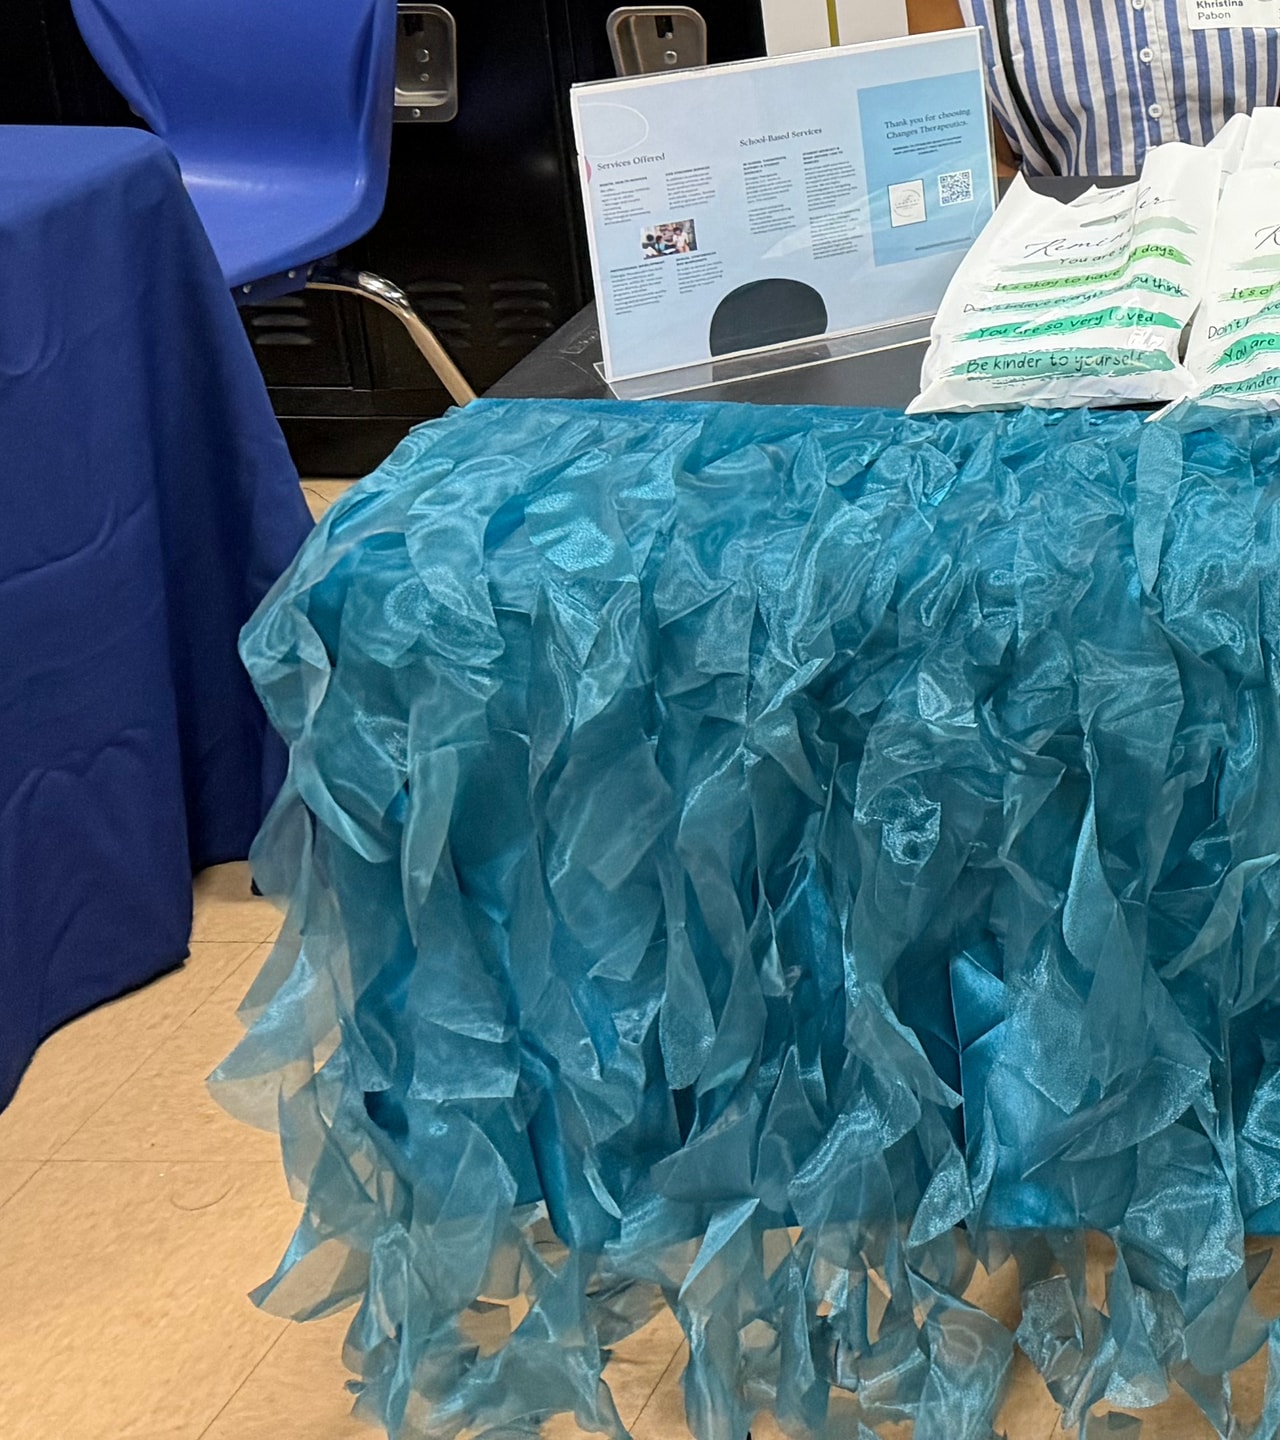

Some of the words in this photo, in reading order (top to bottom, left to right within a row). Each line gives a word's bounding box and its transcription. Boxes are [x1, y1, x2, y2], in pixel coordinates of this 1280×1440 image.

[1197, 0, 1244, 9] Khristina
[1198, 11, 1231, 20] Pabon
[885, 118, 908, 129] Thank
[910, 116, 923, 126] you
[925, 114, 936, 122] for
[938, 108, 971, 120] choosing
[740, 132, 790, 147] School-Based
[791, 127, 823, 138] Services
[886, 128, 918, 139] Changes
[920, 120, 968, 133] Therapeutics.
[597, 159, 631, 171] Services
[632, 152, 666, 166] Offered
[1250, 337, 1275, 348] are
[966, 359, 988, 373] Be
[993, 355, 1043, 370] kinder
[1050, 353, 1068, 368] to
